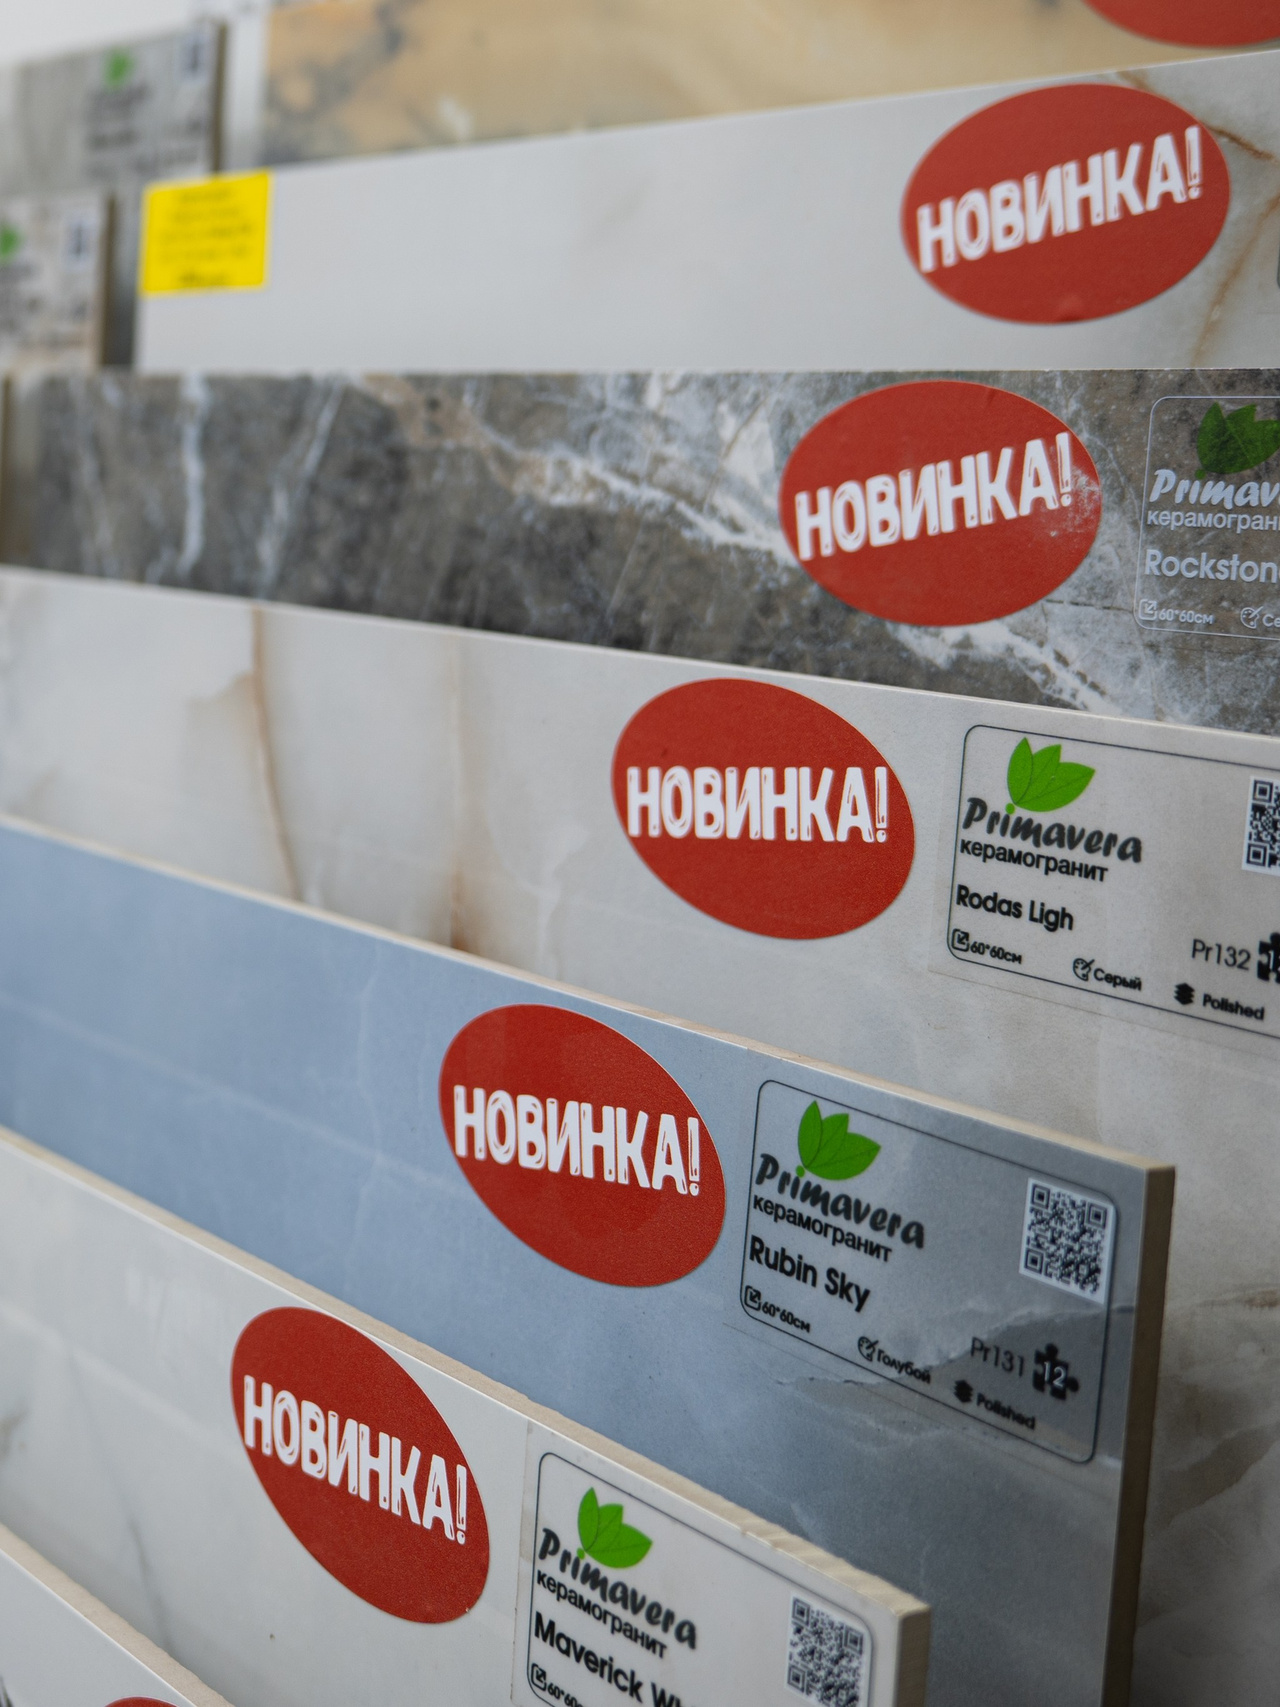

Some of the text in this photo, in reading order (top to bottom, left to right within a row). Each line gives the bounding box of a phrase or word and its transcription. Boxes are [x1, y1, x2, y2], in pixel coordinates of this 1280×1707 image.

[916, 125, 1202, 274] НОВИНКА!
[794, 431, 1074, 560] НОВИНКА!
[1146, 510, 1280, 534] керамогран
[1149, 469, 1280, 510] Primav
[1144, 549, 1280, 584] Rockston
[626, 765, 888, 843] НОВИНКА!
[961, 796, 1143, 864] Primavera
[959, 838, 1109, 882] керамогранит
[955, 884, 1074, 932] Rodas Ligh
[1093, 966, 1143, 991] Серый
[1191, 938, 1252, 971] Pr132
[1202, 993, 1266, 1021] Polished
[453, 1084, 700, 1197] НОВИНКА!
[752, 1194, 893, 1263] керамогранит
[755, 1152, 926, 1250] Primavera
[749, 1234, 871, 1314] Rubin Sky
[876, 1348, 931, 1385] Голубой
[970, 1337, 1067, 1388] Pr131 12
[976, 1392, 1036, 1430] Polished
[243, 1374, 468, 1545] НОВИНКА!
[536, 1569, 668, 1659] керамогранит
[537, 1527, 698, 1650] Primavera
[534, 1611, 643, 1703] Maverick
